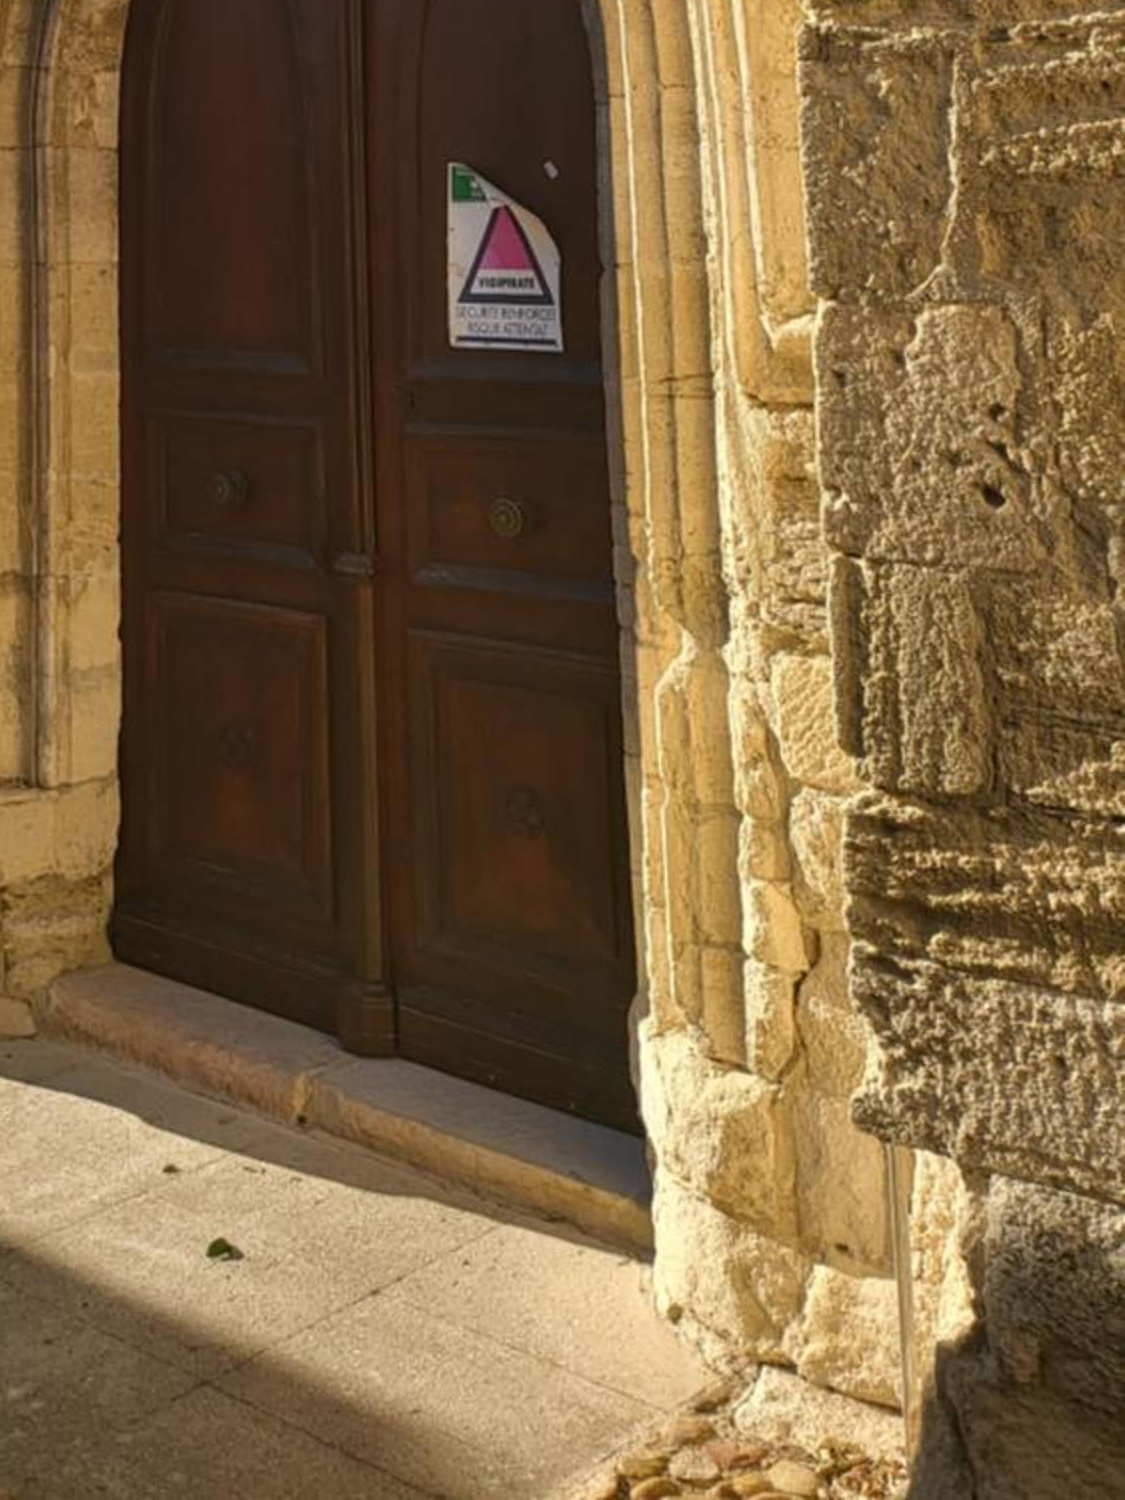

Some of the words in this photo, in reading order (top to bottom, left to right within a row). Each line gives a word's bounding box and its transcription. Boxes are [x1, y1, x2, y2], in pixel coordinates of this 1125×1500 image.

[479, 277, 535, 289] VIGIPIRATE
[467, 322, 501, 335] RISQUE
[503, 323, 548, 336] ATTENTAT
